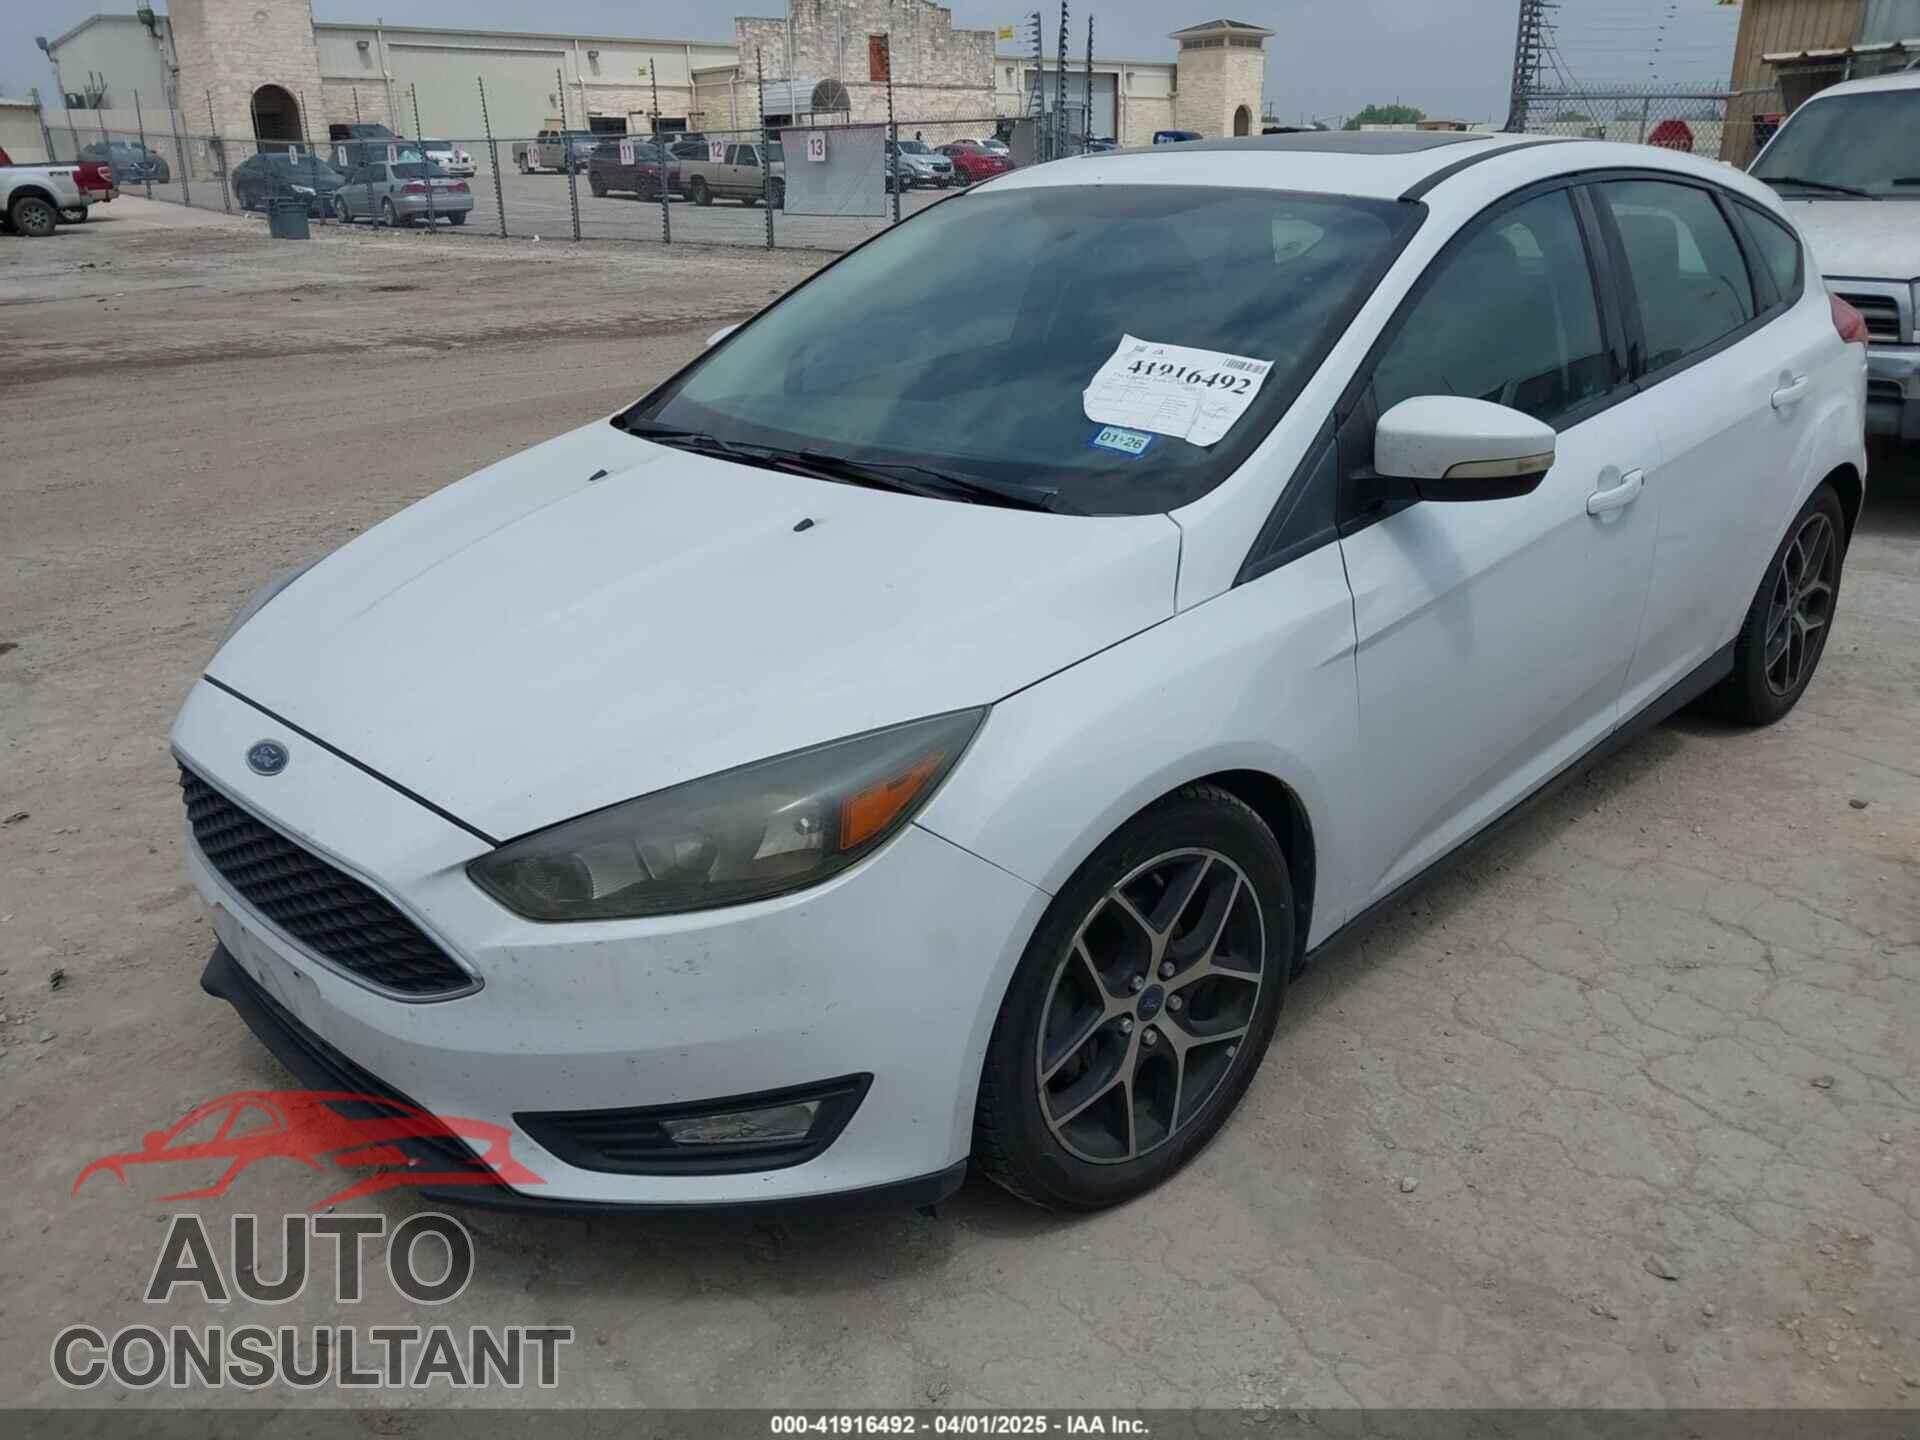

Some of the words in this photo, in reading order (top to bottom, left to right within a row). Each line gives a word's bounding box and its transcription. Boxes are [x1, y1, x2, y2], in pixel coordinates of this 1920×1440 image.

[528, 146, 539, 164] 10
[621, 144, 633, 161] 11
[711, 141, 723, 158] 12
[810, 139, 823, 156] 13
[1127, 360, 1252, 395] 41916492
